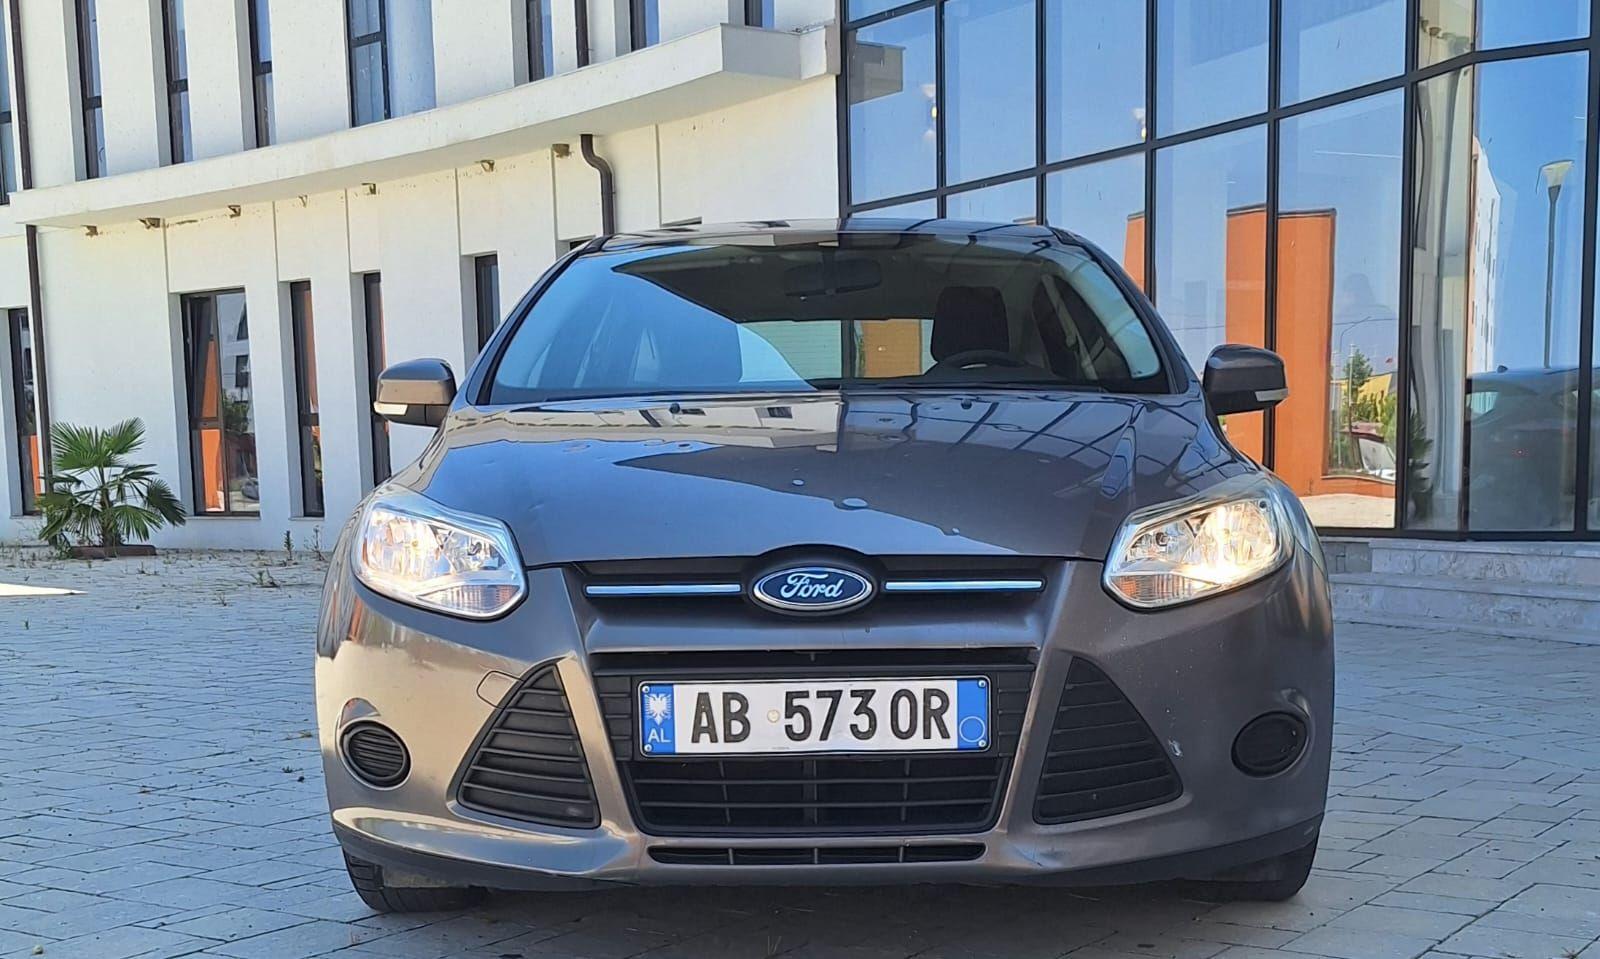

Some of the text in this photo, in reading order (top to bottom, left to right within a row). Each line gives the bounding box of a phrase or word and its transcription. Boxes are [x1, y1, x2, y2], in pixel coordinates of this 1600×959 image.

[780, 572, 844, 598] Ford
[691, 691, 751, 743] AB
[784, 689, 877, 741] 573
[648, 728, 672, 743] AL
